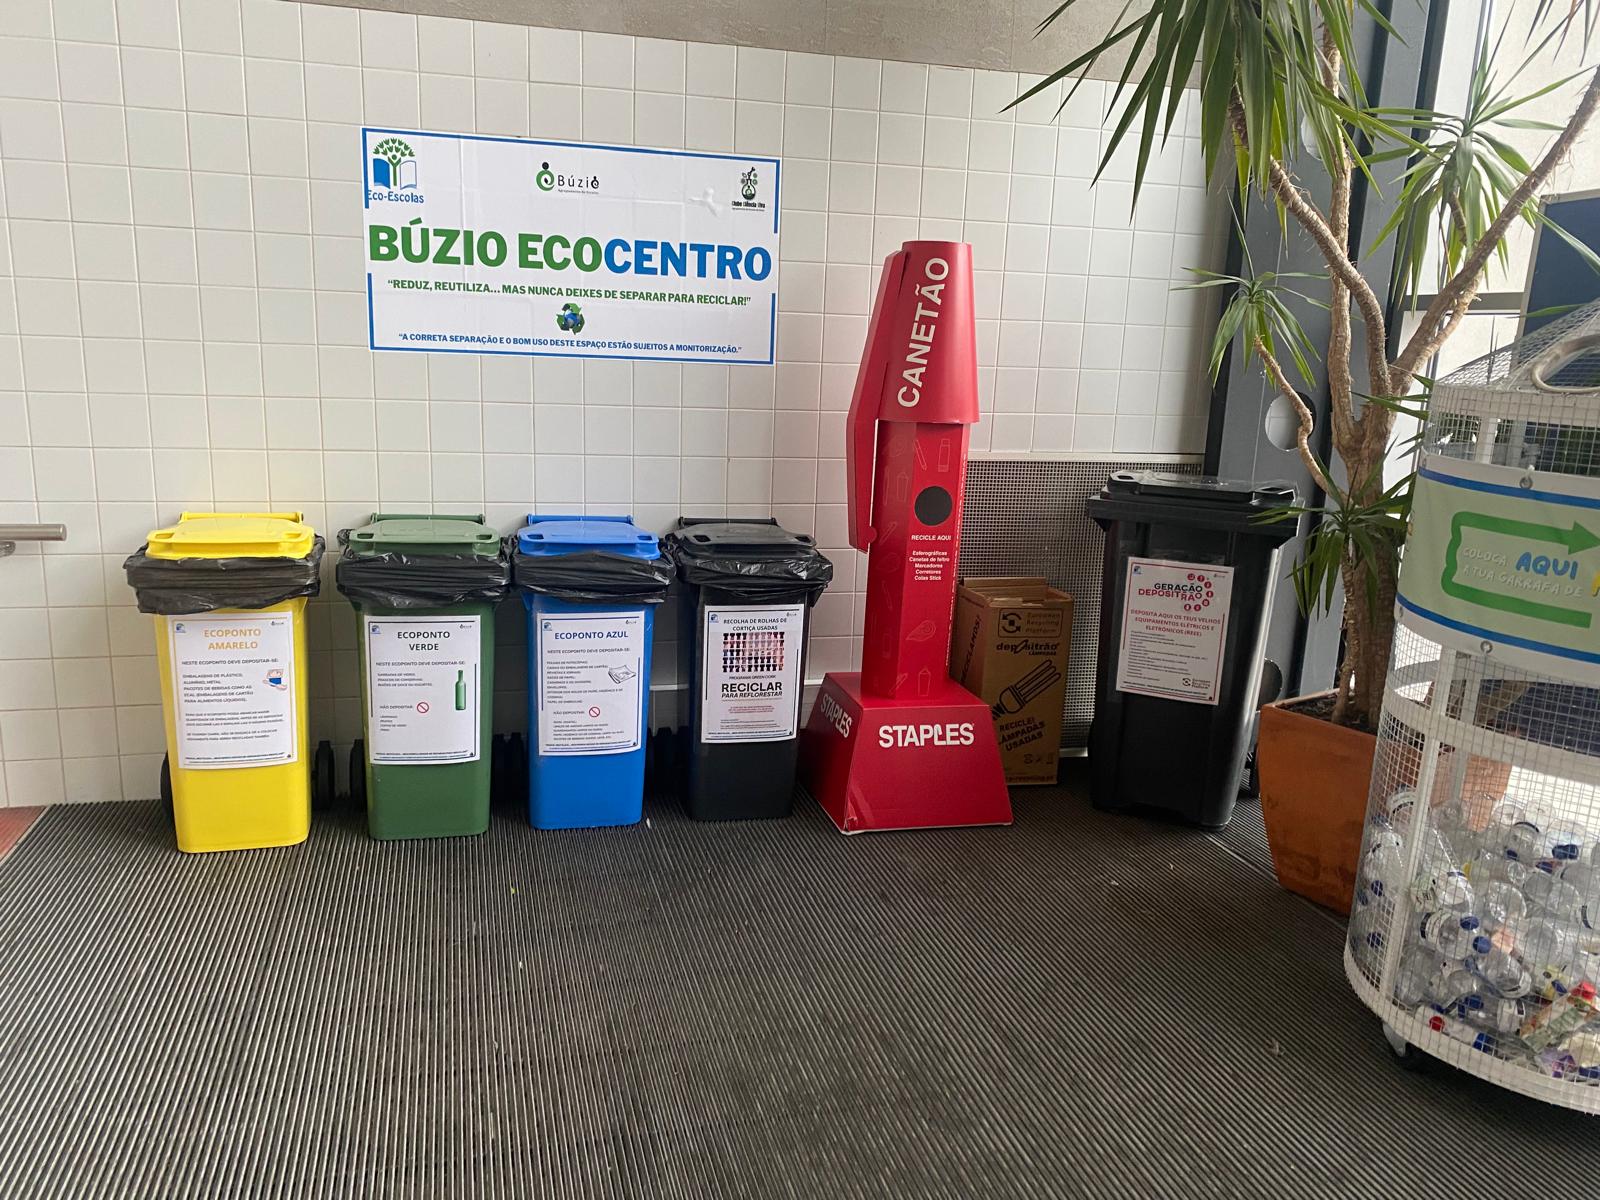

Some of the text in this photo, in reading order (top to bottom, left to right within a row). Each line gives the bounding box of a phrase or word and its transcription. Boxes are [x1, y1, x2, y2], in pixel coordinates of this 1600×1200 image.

[368, 190, 425, 204] Eco-Escolas
[369, 217, 771, 282] BÚZIO ECOCENTRO
[502, 285, 526, 295] MAS
[528, 286, 564, 297] NUNCA
[565, 288, 602, 298] DEIXES
[604, 289, 618, 299] DE
[619, 290, 667, 302] SEPARAR
[668, 293, 695, 304] PARA
[897, 257, 949, 408] CANETÃO
[410, 334, 448, 342] CORRETA
[449, 335, 498, 344] SEPARAÇÃO
[576, 340, 607, 349] ESPAÇO
[607, 340, 632, 349] ESTÃO
[633, 342, 668, 351] SUJEITOS
[1462, 547, 1579, 581] COLOCA AQUI
[1154, 582, 1203, 593] GERAÇÃO
[1472, 566, 1496, 581] TUA
[1498, 574, 1561, 594] GARRAFA
[1563, 586, 1585, 597] DE
[1138, 588, 1202, 601] DEPOSITRÃO
[1135, 617, 1179, 627] EQUIPAMENTOS
[203, 628, 262, 638] ECOPONTO
[208, 641, 259, 650] AMARELO
[721, 681, 782, 693] RECICLAR
[820, 693, 853, 738] STAPLES
[878, 722, 974, 749] STAPLES
[1005, 731, 1044, 752] USADAS
